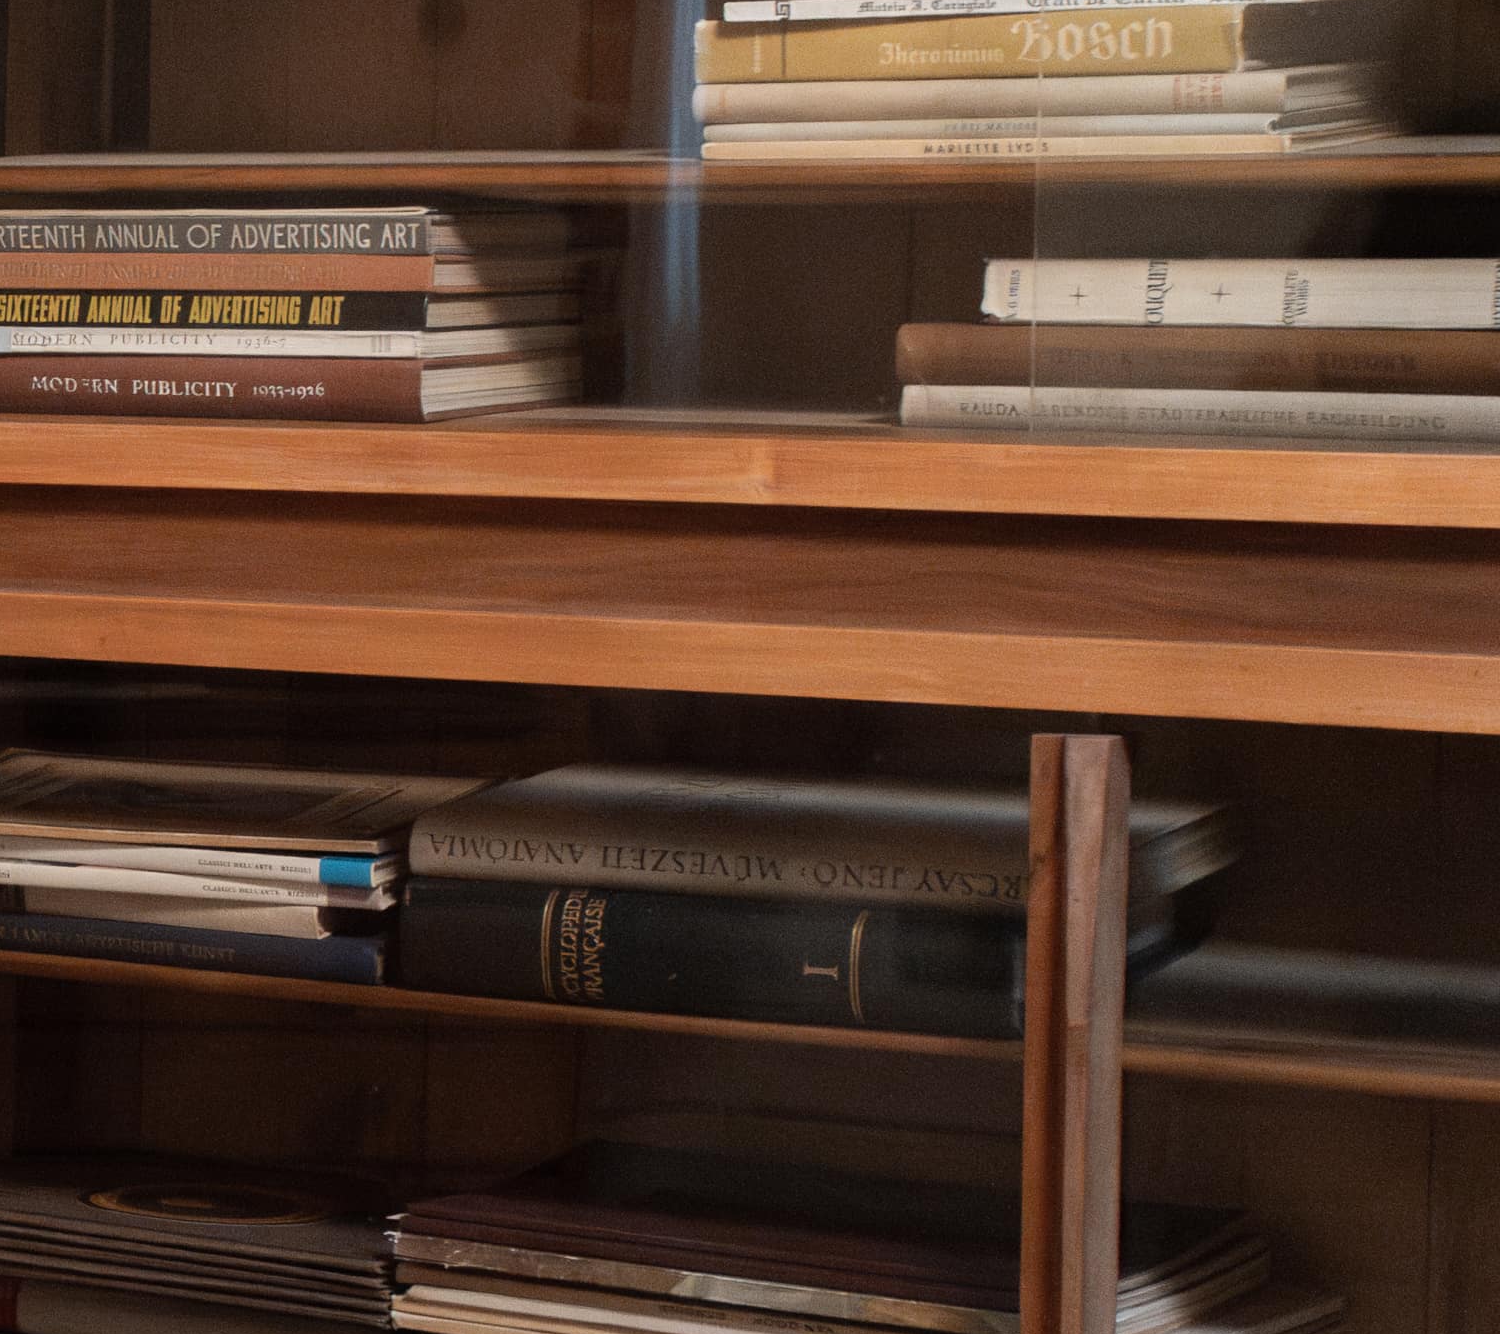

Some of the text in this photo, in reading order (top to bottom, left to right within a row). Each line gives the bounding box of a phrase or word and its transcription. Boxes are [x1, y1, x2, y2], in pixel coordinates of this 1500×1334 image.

[1009, 17, 1174, 62] Bosch
[923, 142, 1049, 155] MARIETTE LYDS
[94, 224, 179, 249] ANNUAL
[186, 224, 222, 249] OF
[230, 223, 371, 250] ADVERTISING
[380, 222, 420, 249] ART
[86, 295, 152, 324] ANNUAL
[159, 295, 183, 323] OF
[188, 295, 301, 325] ADVERTISING
[307, 295, 346, 325] ART
[109, 333, 218, 346] PUBLICITY
[131, 380, 238, 398] PUBLICITY
[959, 402, 1020, 417] RAUDA
